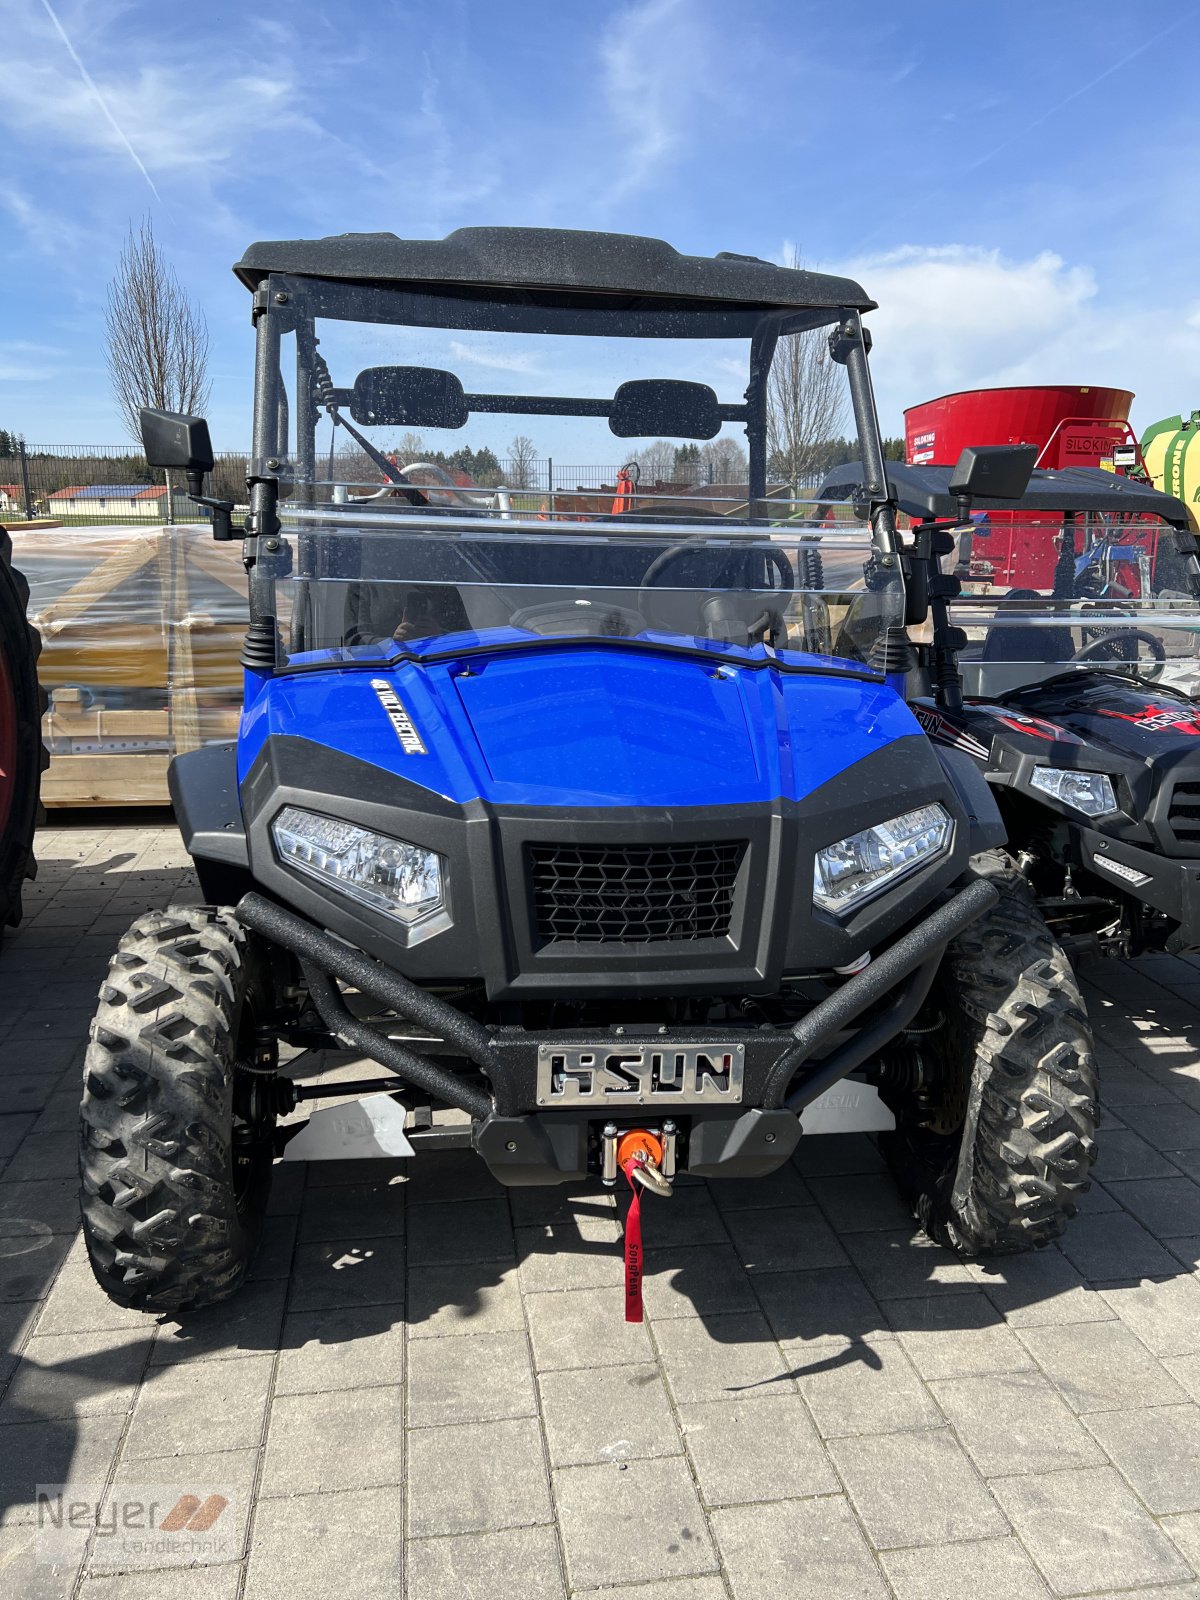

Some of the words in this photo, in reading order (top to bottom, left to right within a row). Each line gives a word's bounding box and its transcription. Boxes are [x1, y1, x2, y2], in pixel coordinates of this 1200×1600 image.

[376, 690, 403, 710] VOLT
[389, 712, 425, 753] ELECTRIC
[550, 1054, 732, 1096] HSUN
[628, 1243, 640, 1297] SongPeng
